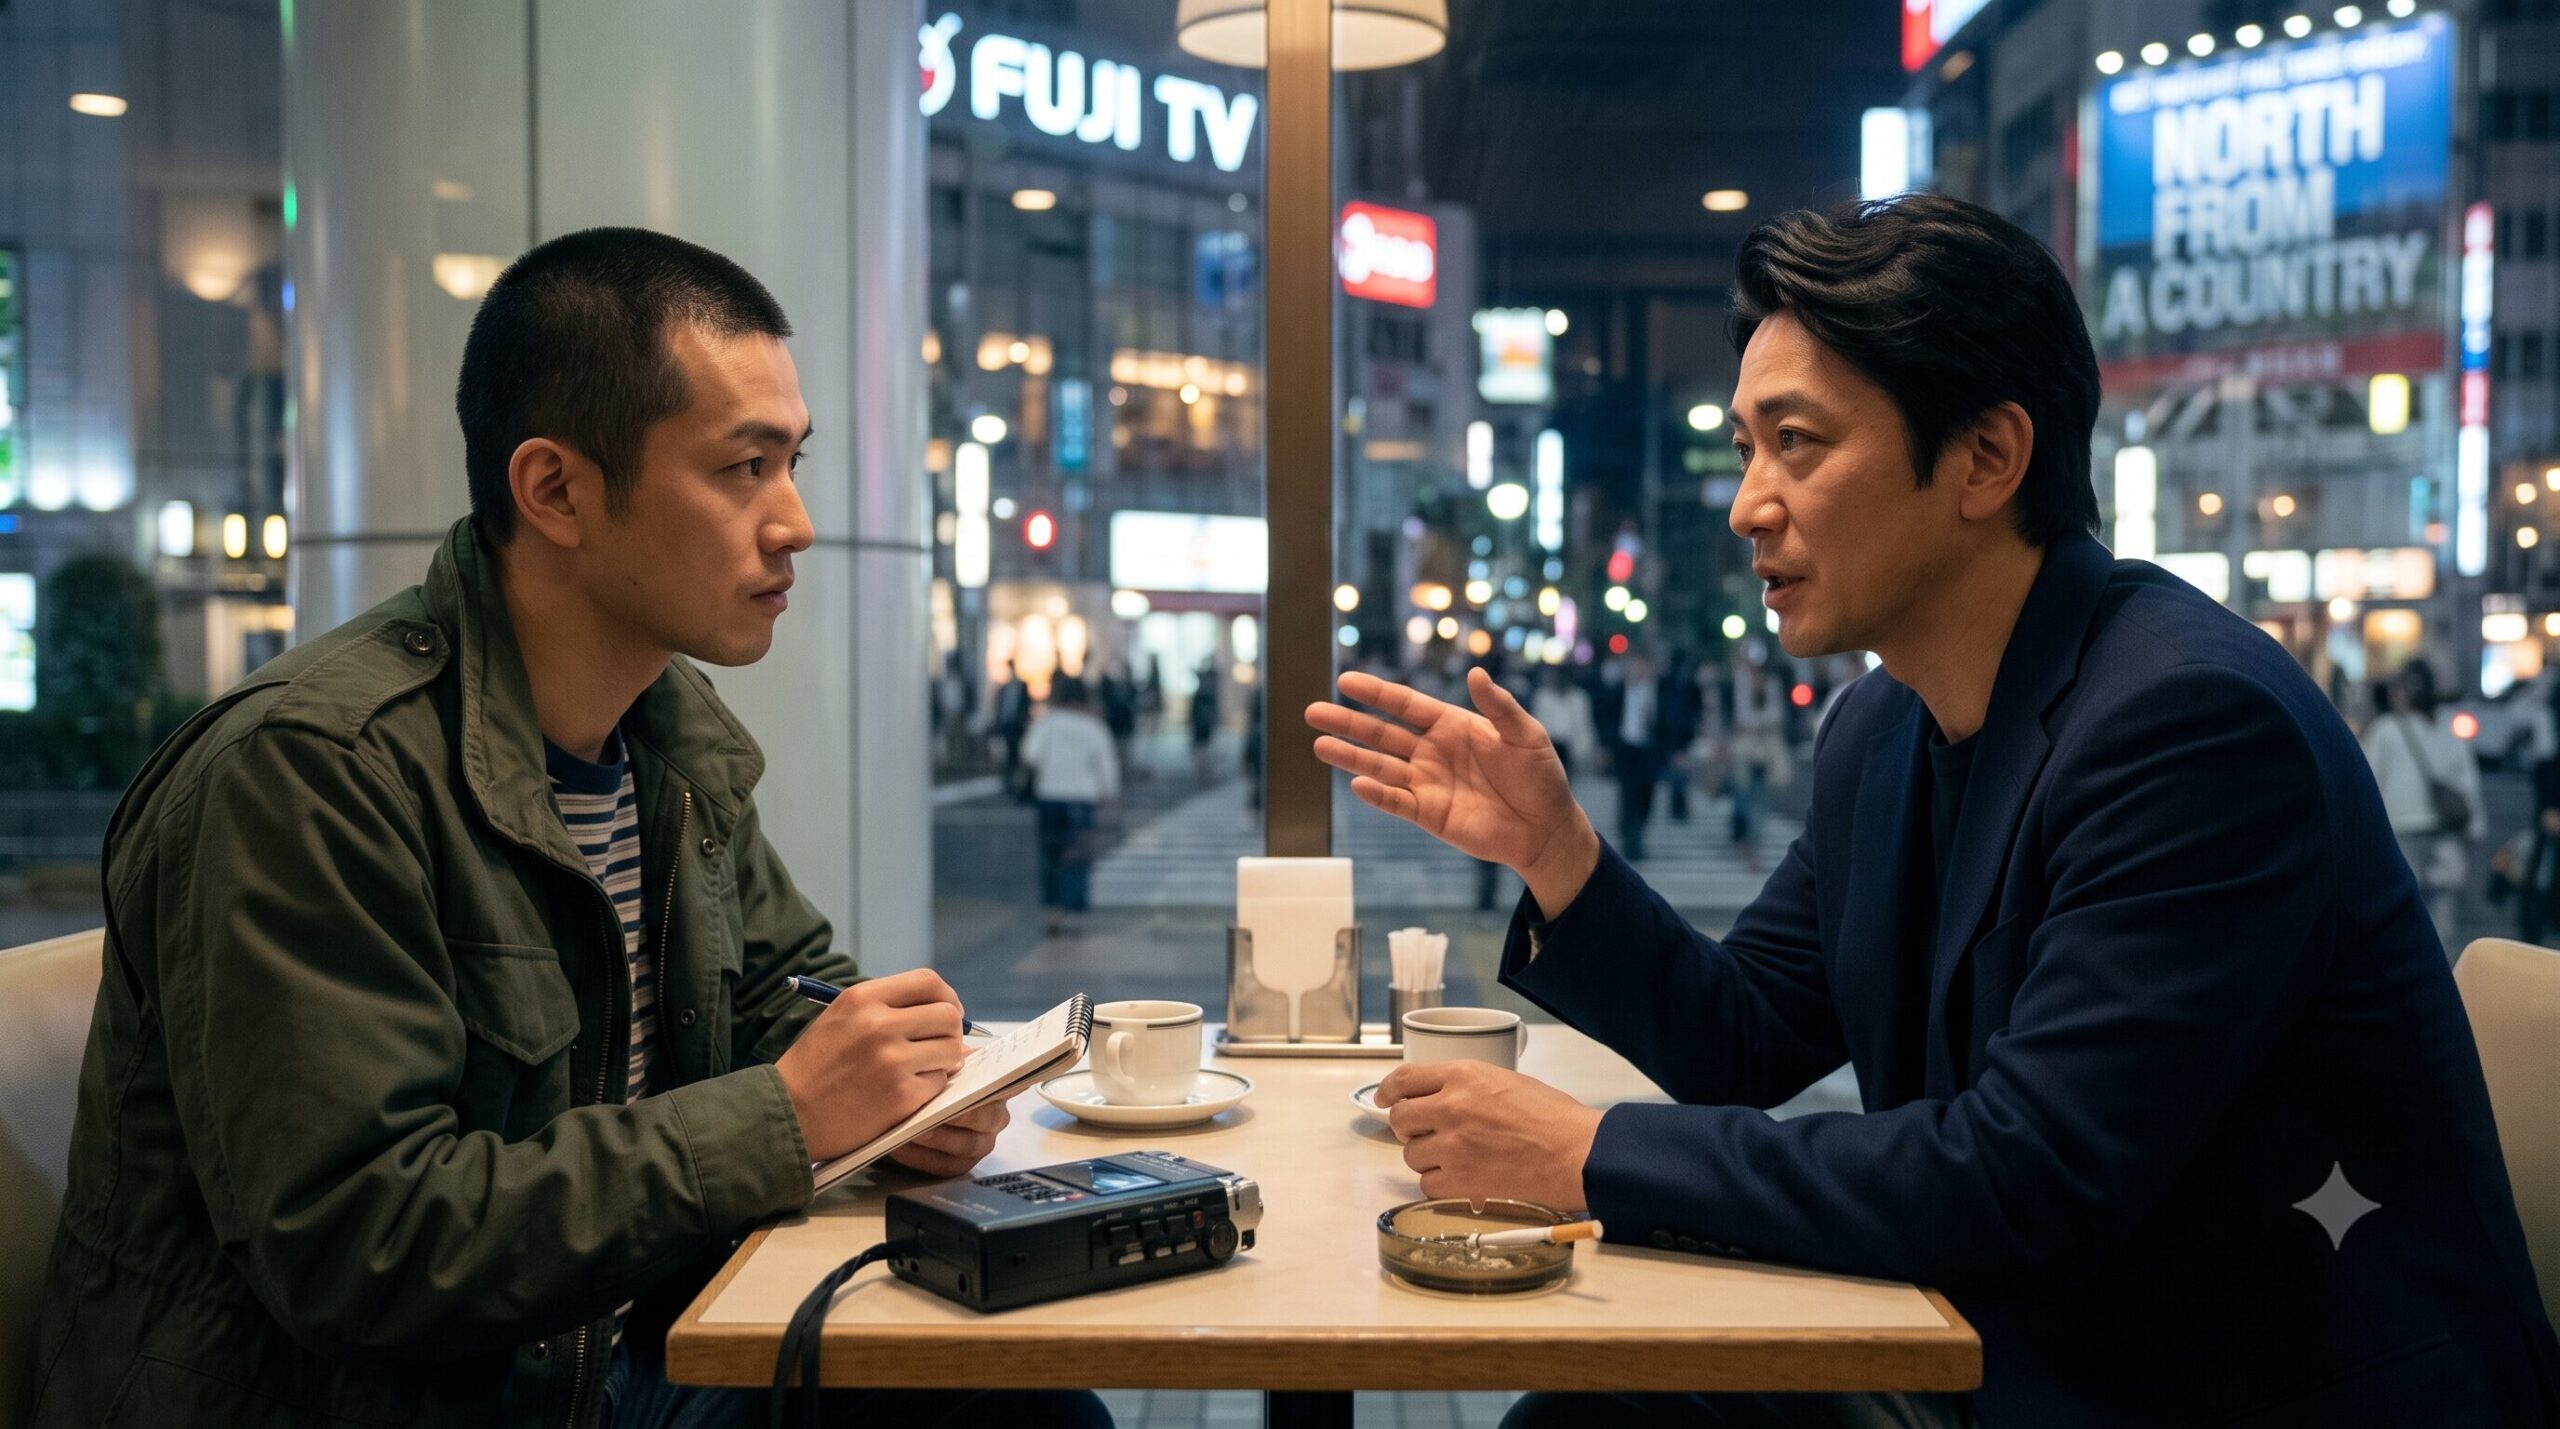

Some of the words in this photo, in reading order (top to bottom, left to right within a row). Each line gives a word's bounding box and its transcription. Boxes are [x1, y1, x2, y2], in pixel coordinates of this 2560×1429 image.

[971, 34, 1141, 151] FUJI
[1154, 74, 1258, 171] TV
[2153, 73, 2386, 184] NORTH
[2153, 166, 2336, 261] FROM
[2102, 267, 2147, 338] A
[2150, 230, 2429, 333] COUNTRY
